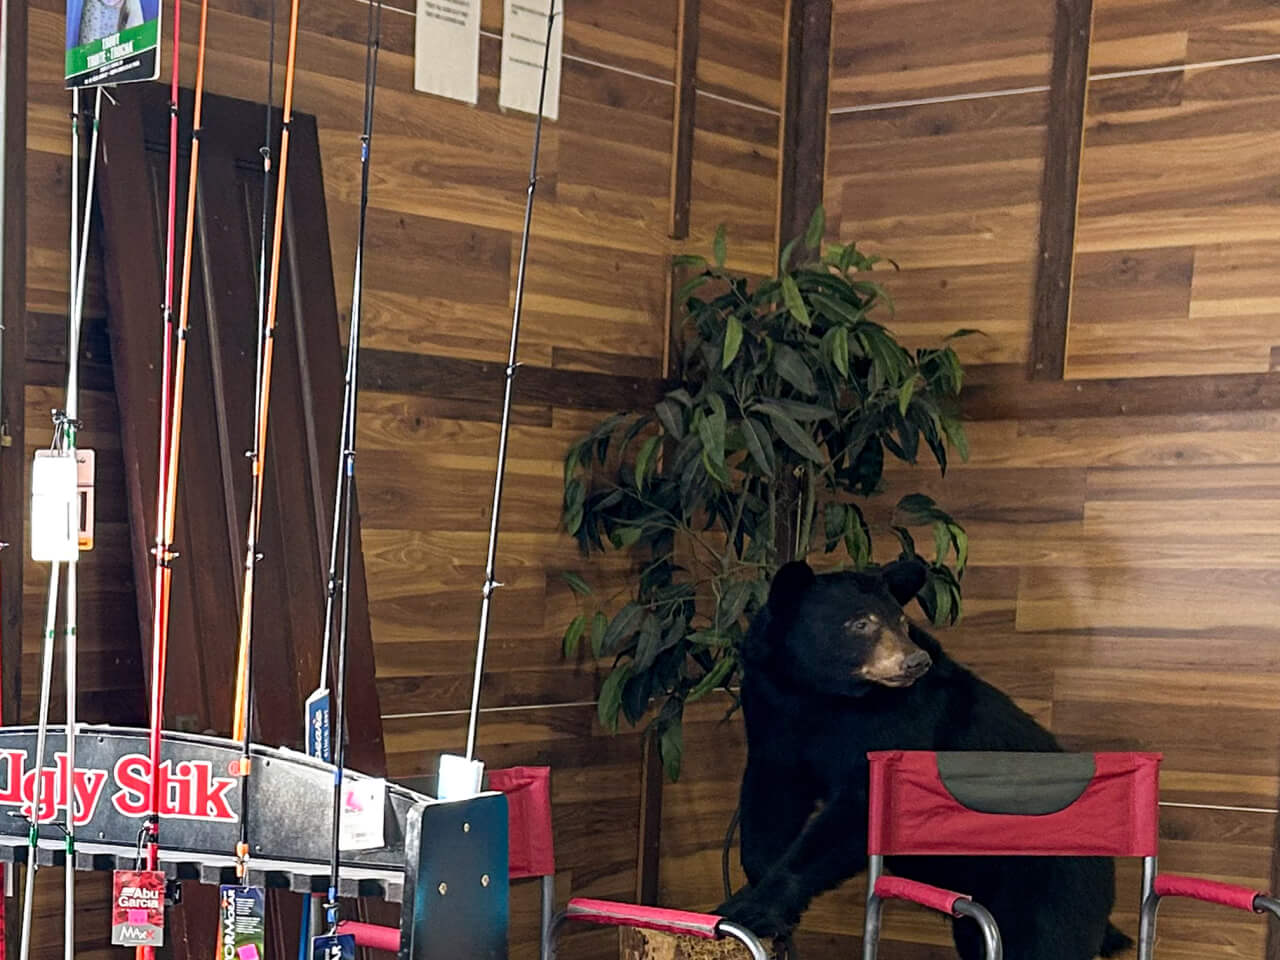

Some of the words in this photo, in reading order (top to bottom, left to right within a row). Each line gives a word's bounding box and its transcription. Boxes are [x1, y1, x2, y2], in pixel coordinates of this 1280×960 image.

[111, 753, 238, 823] Stik
[133, 887, 159, 899] Abu
[118, 896, 159, 908] Garcia
